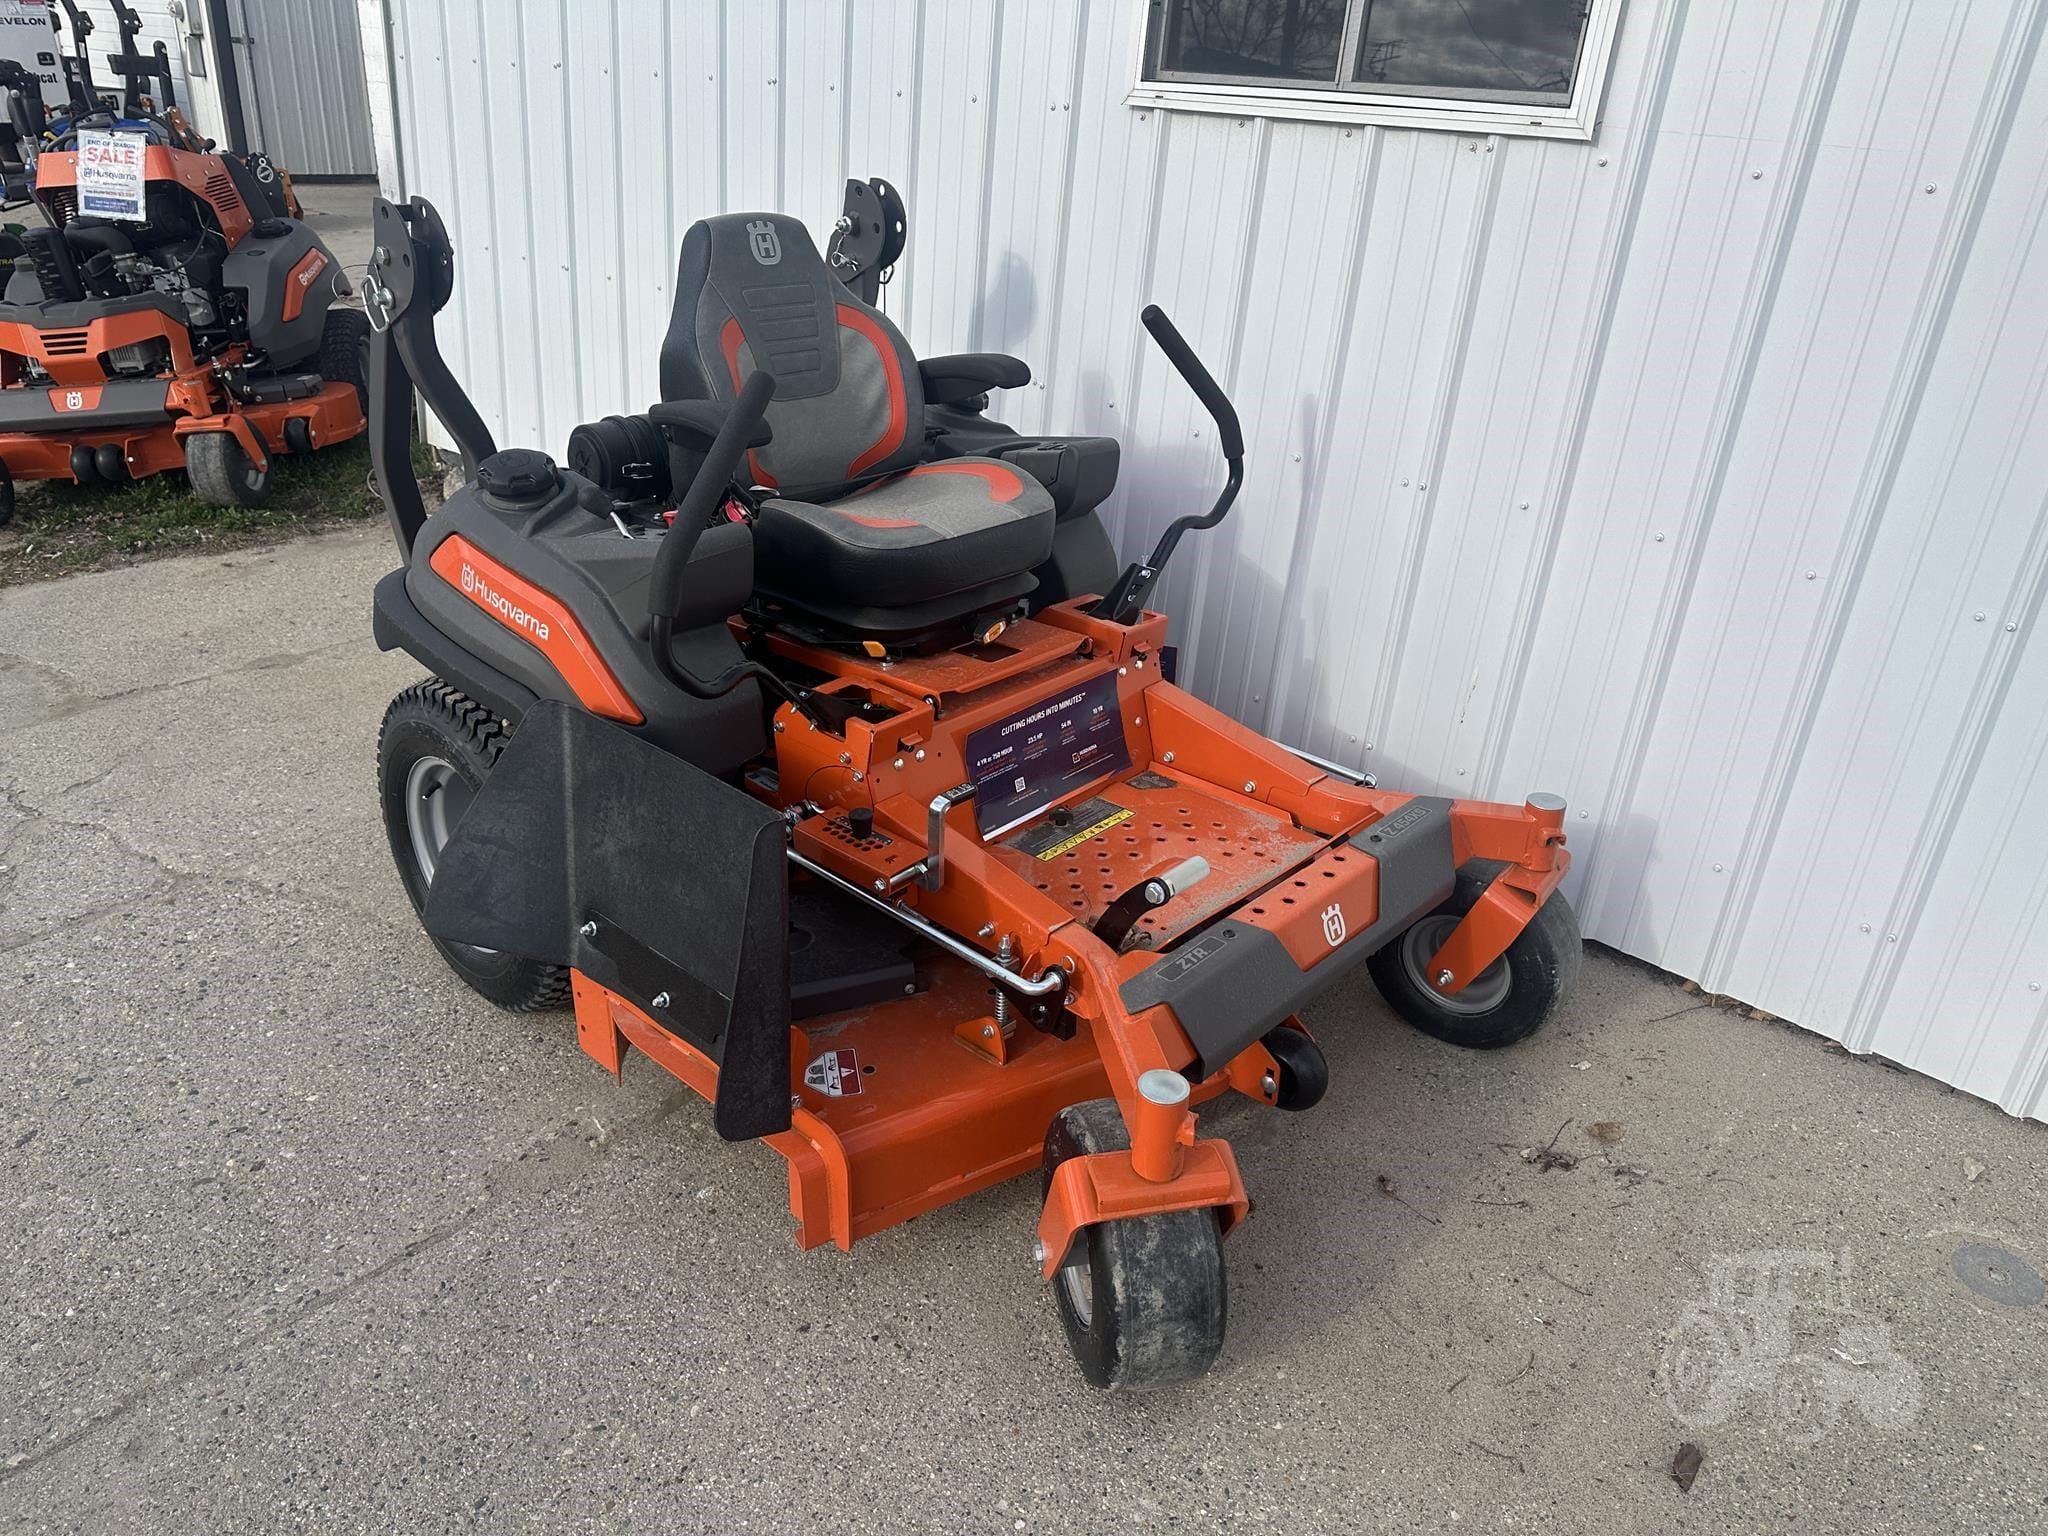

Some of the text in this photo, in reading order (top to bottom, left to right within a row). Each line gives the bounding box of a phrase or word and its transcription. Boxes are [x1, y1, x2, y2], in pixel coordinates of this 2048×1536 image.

[87, 147, 136, 165] SALE
[93, 169, 137, 181] Husqvarna
[474, 574, 550, 641] Husqvarna
[1001, 719, 1026, 736] CUTTING
[1026, 710, 1046, 726] HOURS
[1045, 704, 1059, 717] INTO
[1383, 827, 1398, 836] Z
